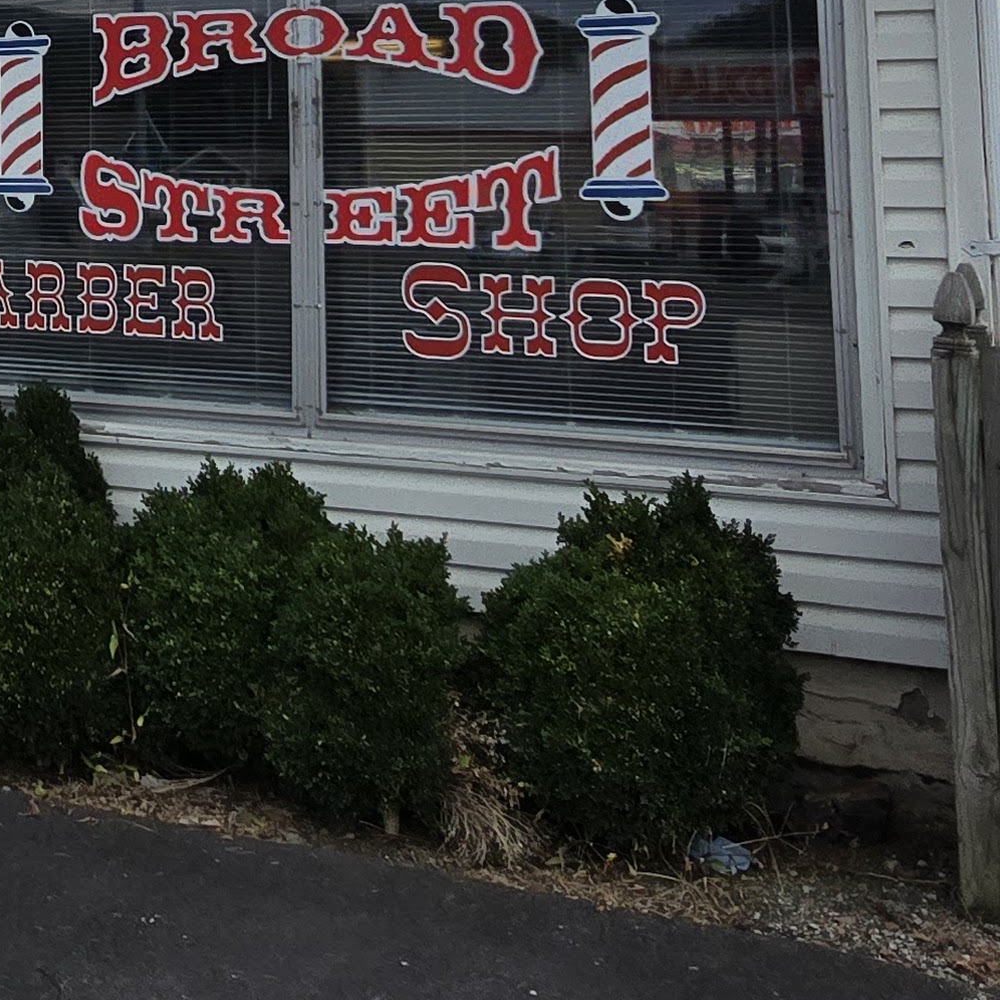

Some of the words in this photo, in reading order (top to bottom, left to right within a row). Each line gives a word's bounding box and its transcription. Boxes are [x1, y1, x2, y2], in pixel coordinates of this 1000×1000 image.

[92, 1, 544, 106] BROAD
[79, 146, 560, 253] STREET
[401, 262, 706, 366] SHOP
